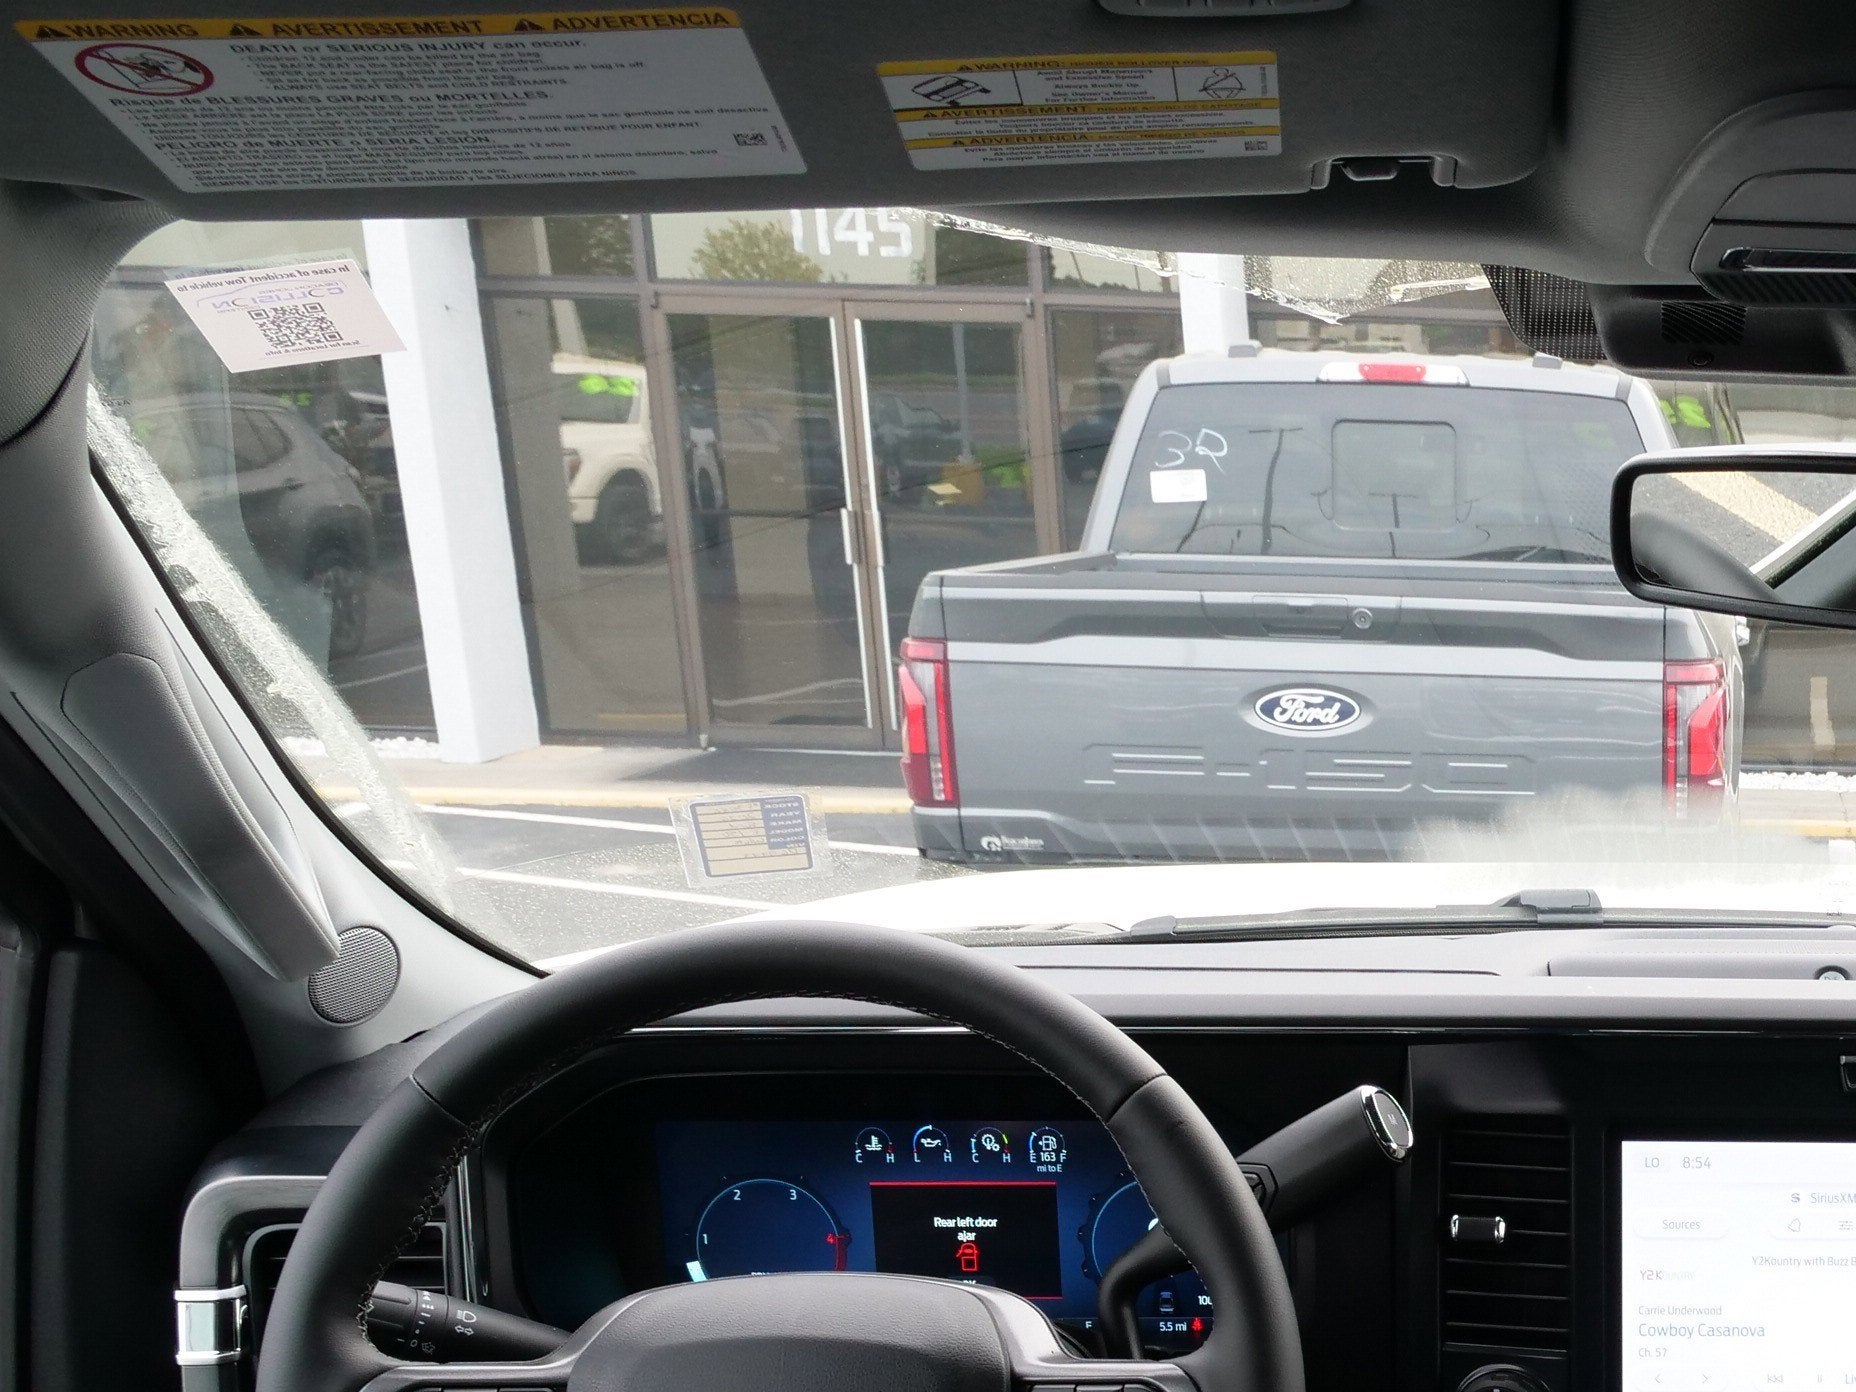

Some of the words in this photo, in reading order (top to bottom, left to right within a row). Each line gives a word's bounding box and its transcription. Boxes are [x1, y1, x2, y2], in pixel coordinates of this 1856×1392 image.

[552, 12, 730, 30] ADVERTENCIA
[66, 23, 199, 38] WARNING
[271, 20, 483, 36] AVERTISSEMENT
[230, 43, 296, 54] DEATH
[326, 42, 413, 53] SERIOUS
[418, 41, 485, 52] INJURY
[493, 42, 525, 50] can
[206, 95, 322, 105] BLESSURES
[326, 94, 403, 104] GRAVES
[941, 105, 1088, 118] AVERTISSEMENT
[155, 140, 236, 150] PELIGRO
[268, 138, 343, 148] MUERTE
[1273, 694, 1341, 724] Ford
[1083, 742, 1536, 796] F-150
[855, 1153, 863, 1163] C
[886, 1153, 895, 1163] H
[914, 1153, 921, 1162] L
[943, 1152, 952, 1163] H
[972, 1153, 979, 1163] C
[1002, 1153, 1011, 1163] H
[1030, 1153, 1037, 1163] E
[1040, 1152, 1056, 1162] 163
[1060, 1153, 1067, 1163] F
[1643, 1156, 1660, 1168] LO
[1681, 1156, 1712, 1169] 8:54
[733, 1189, 741, 1200] 2
[789, 1189, 798, 1200] 3
[933, 1216, 956, 1228] Rear
[956, 1216, 975, 1228] left
[975, 1216, 998, 1228] door
[1662, 1218, 1701, 1230] Sources
[825, 1232, 835, 1244] 4
[957, 1230, 976, 1242] ajar
[1751, 1255, 1801, 1268] Y2Kountry
[1803, 1256, 1826, 1267] with
[1826, 1257, 1848, 1267] Buzz
[1638, 1305, 1666, 1316] Carrie
[1668, 1305, 1723, 1316] Underwood
[1159, 1321, 1173, 1332] 5.5
[1175, 1321, 1187, 1332] mi
[1638, 1323, 1694, 1339] Cowboy
[1698, 1323, 1766, 1338] Casanova
[1655, 1347, 1668, 1358] 57
